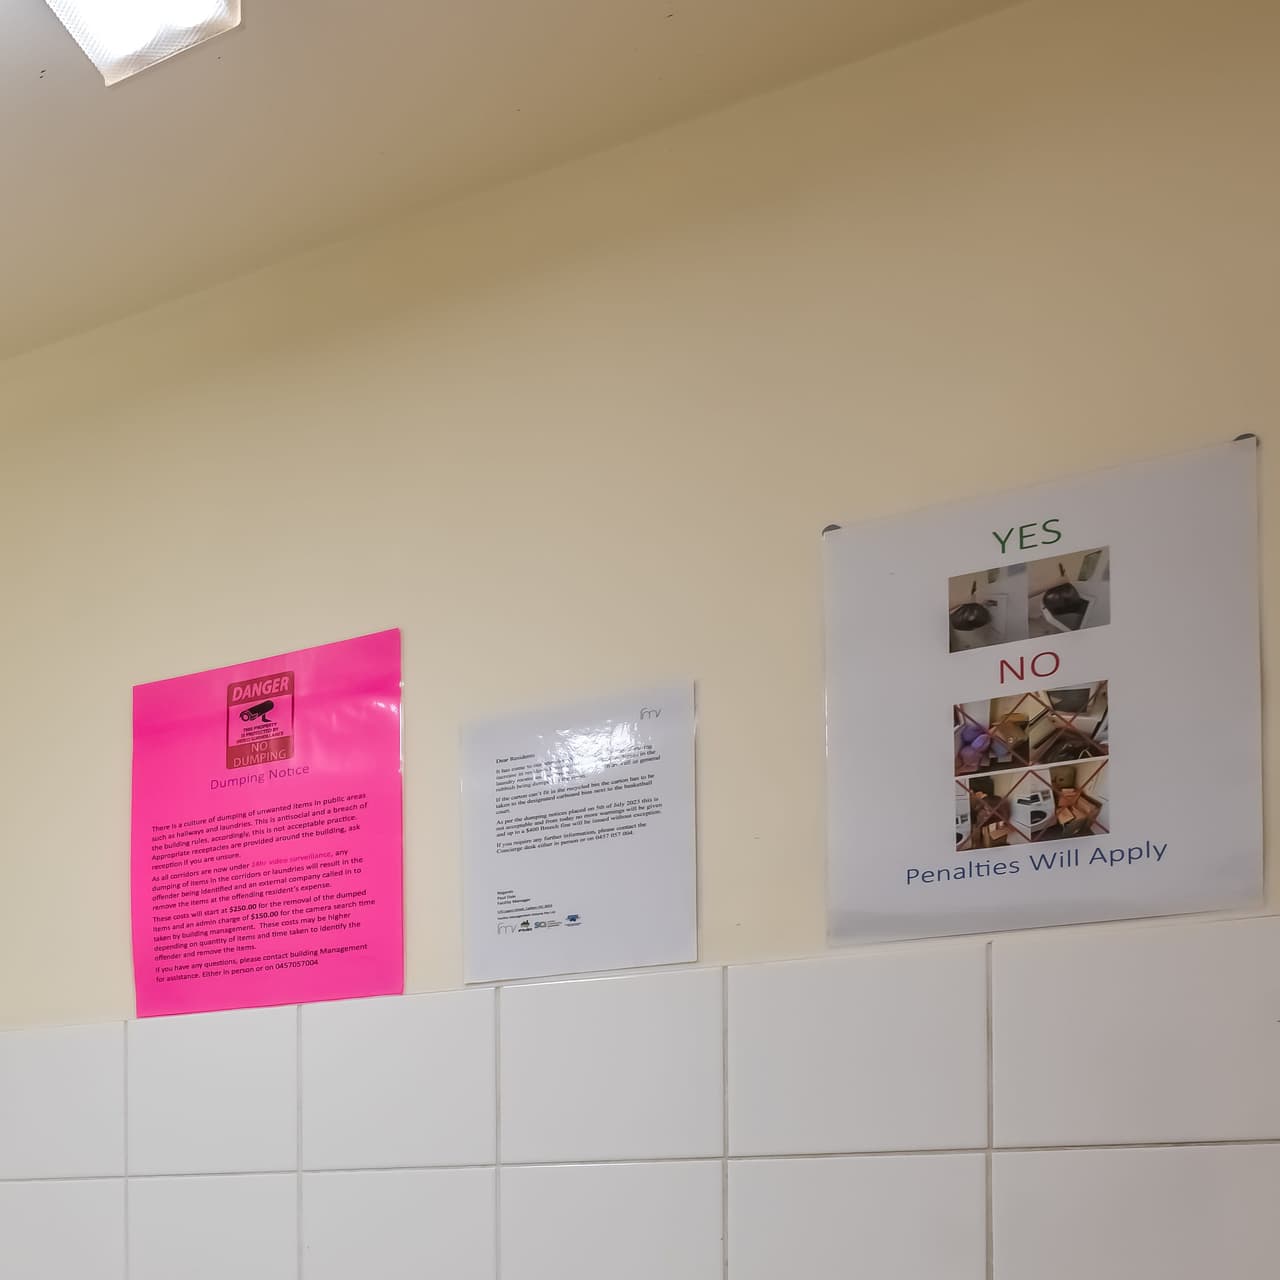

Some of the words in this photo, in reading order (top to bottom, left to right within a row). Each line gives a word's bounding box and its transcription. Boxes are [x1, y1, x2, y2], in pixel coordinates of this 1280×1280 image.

[992, 518, 1063, 555] YES
[998, 651, 1061, 685] NO
[232, 676, 289, 702] DANGER
[233, 749, 287, 768] DUMPING
[251, 741, 268, 753] NO
[211, 773, 265, 790] Dumping
[269, 765, 310, 779] Notice
[906, 858, 1021, 886] Penalties
[1029, 848, 1080, 873] Will
[1089, 840, 1169, 866] Apply
[153, 915, 172, 923] These
[229, 903, 257, 913] $250.00
[283, 896, 312, 905] removal
[336, 889, 367, 899] dumped
[250, 911, 279, 920] $150.00
